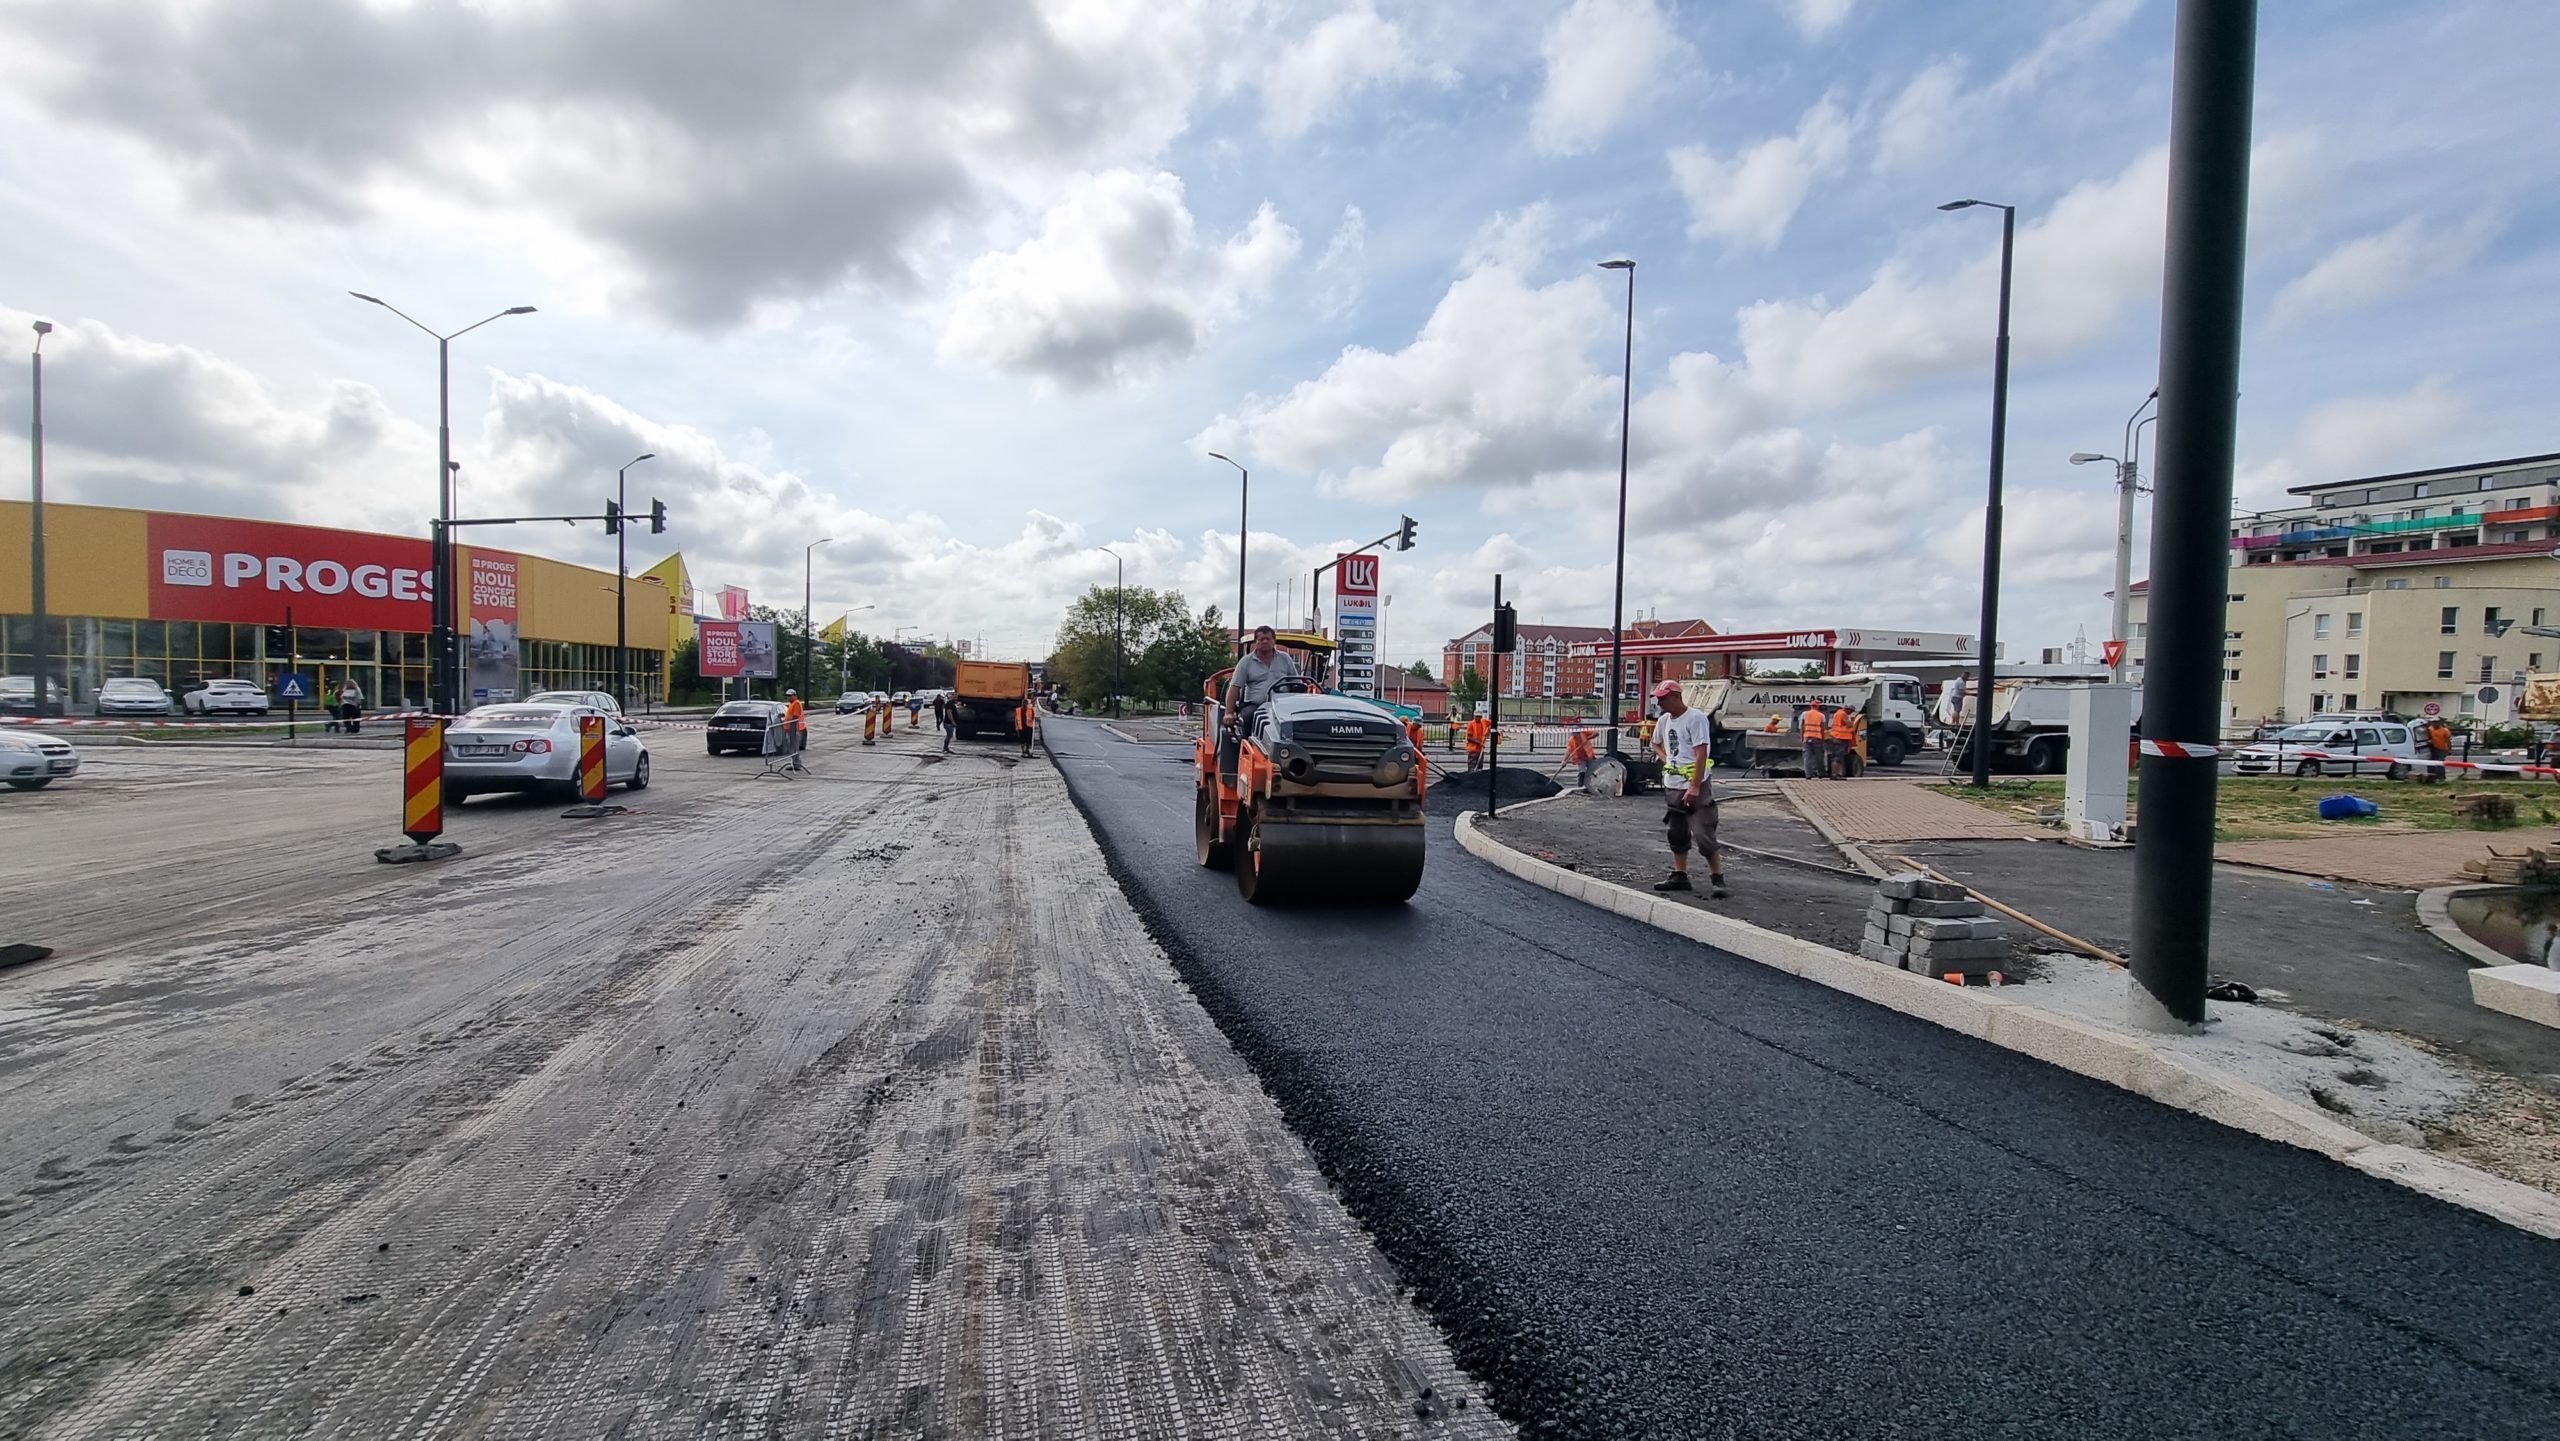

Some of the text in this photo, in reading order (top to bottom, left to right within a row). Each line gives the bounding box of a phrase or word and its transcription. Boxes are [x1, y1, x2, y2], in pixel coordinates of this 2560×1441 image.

[167, 557, 196, 567] HOME
[481, 560, 516, 572] PROGES
[167, 565, 208, 578] DECO
[1344, 559, 1376, 591] LUK
[473, 571, 516, 588] NOUL
[473, 585, 516, 596] CONCEPT
[473, 593, 516, 608] STORE
[707, 638, 736, 646] NOUL
[1786, 632, 1828, 649] LUKOIL
[1897, 637, 1921, 647] LUKOIL
[706, 651, 737, 659] STORE
[1331, 725, 1363, 734] HAMM
